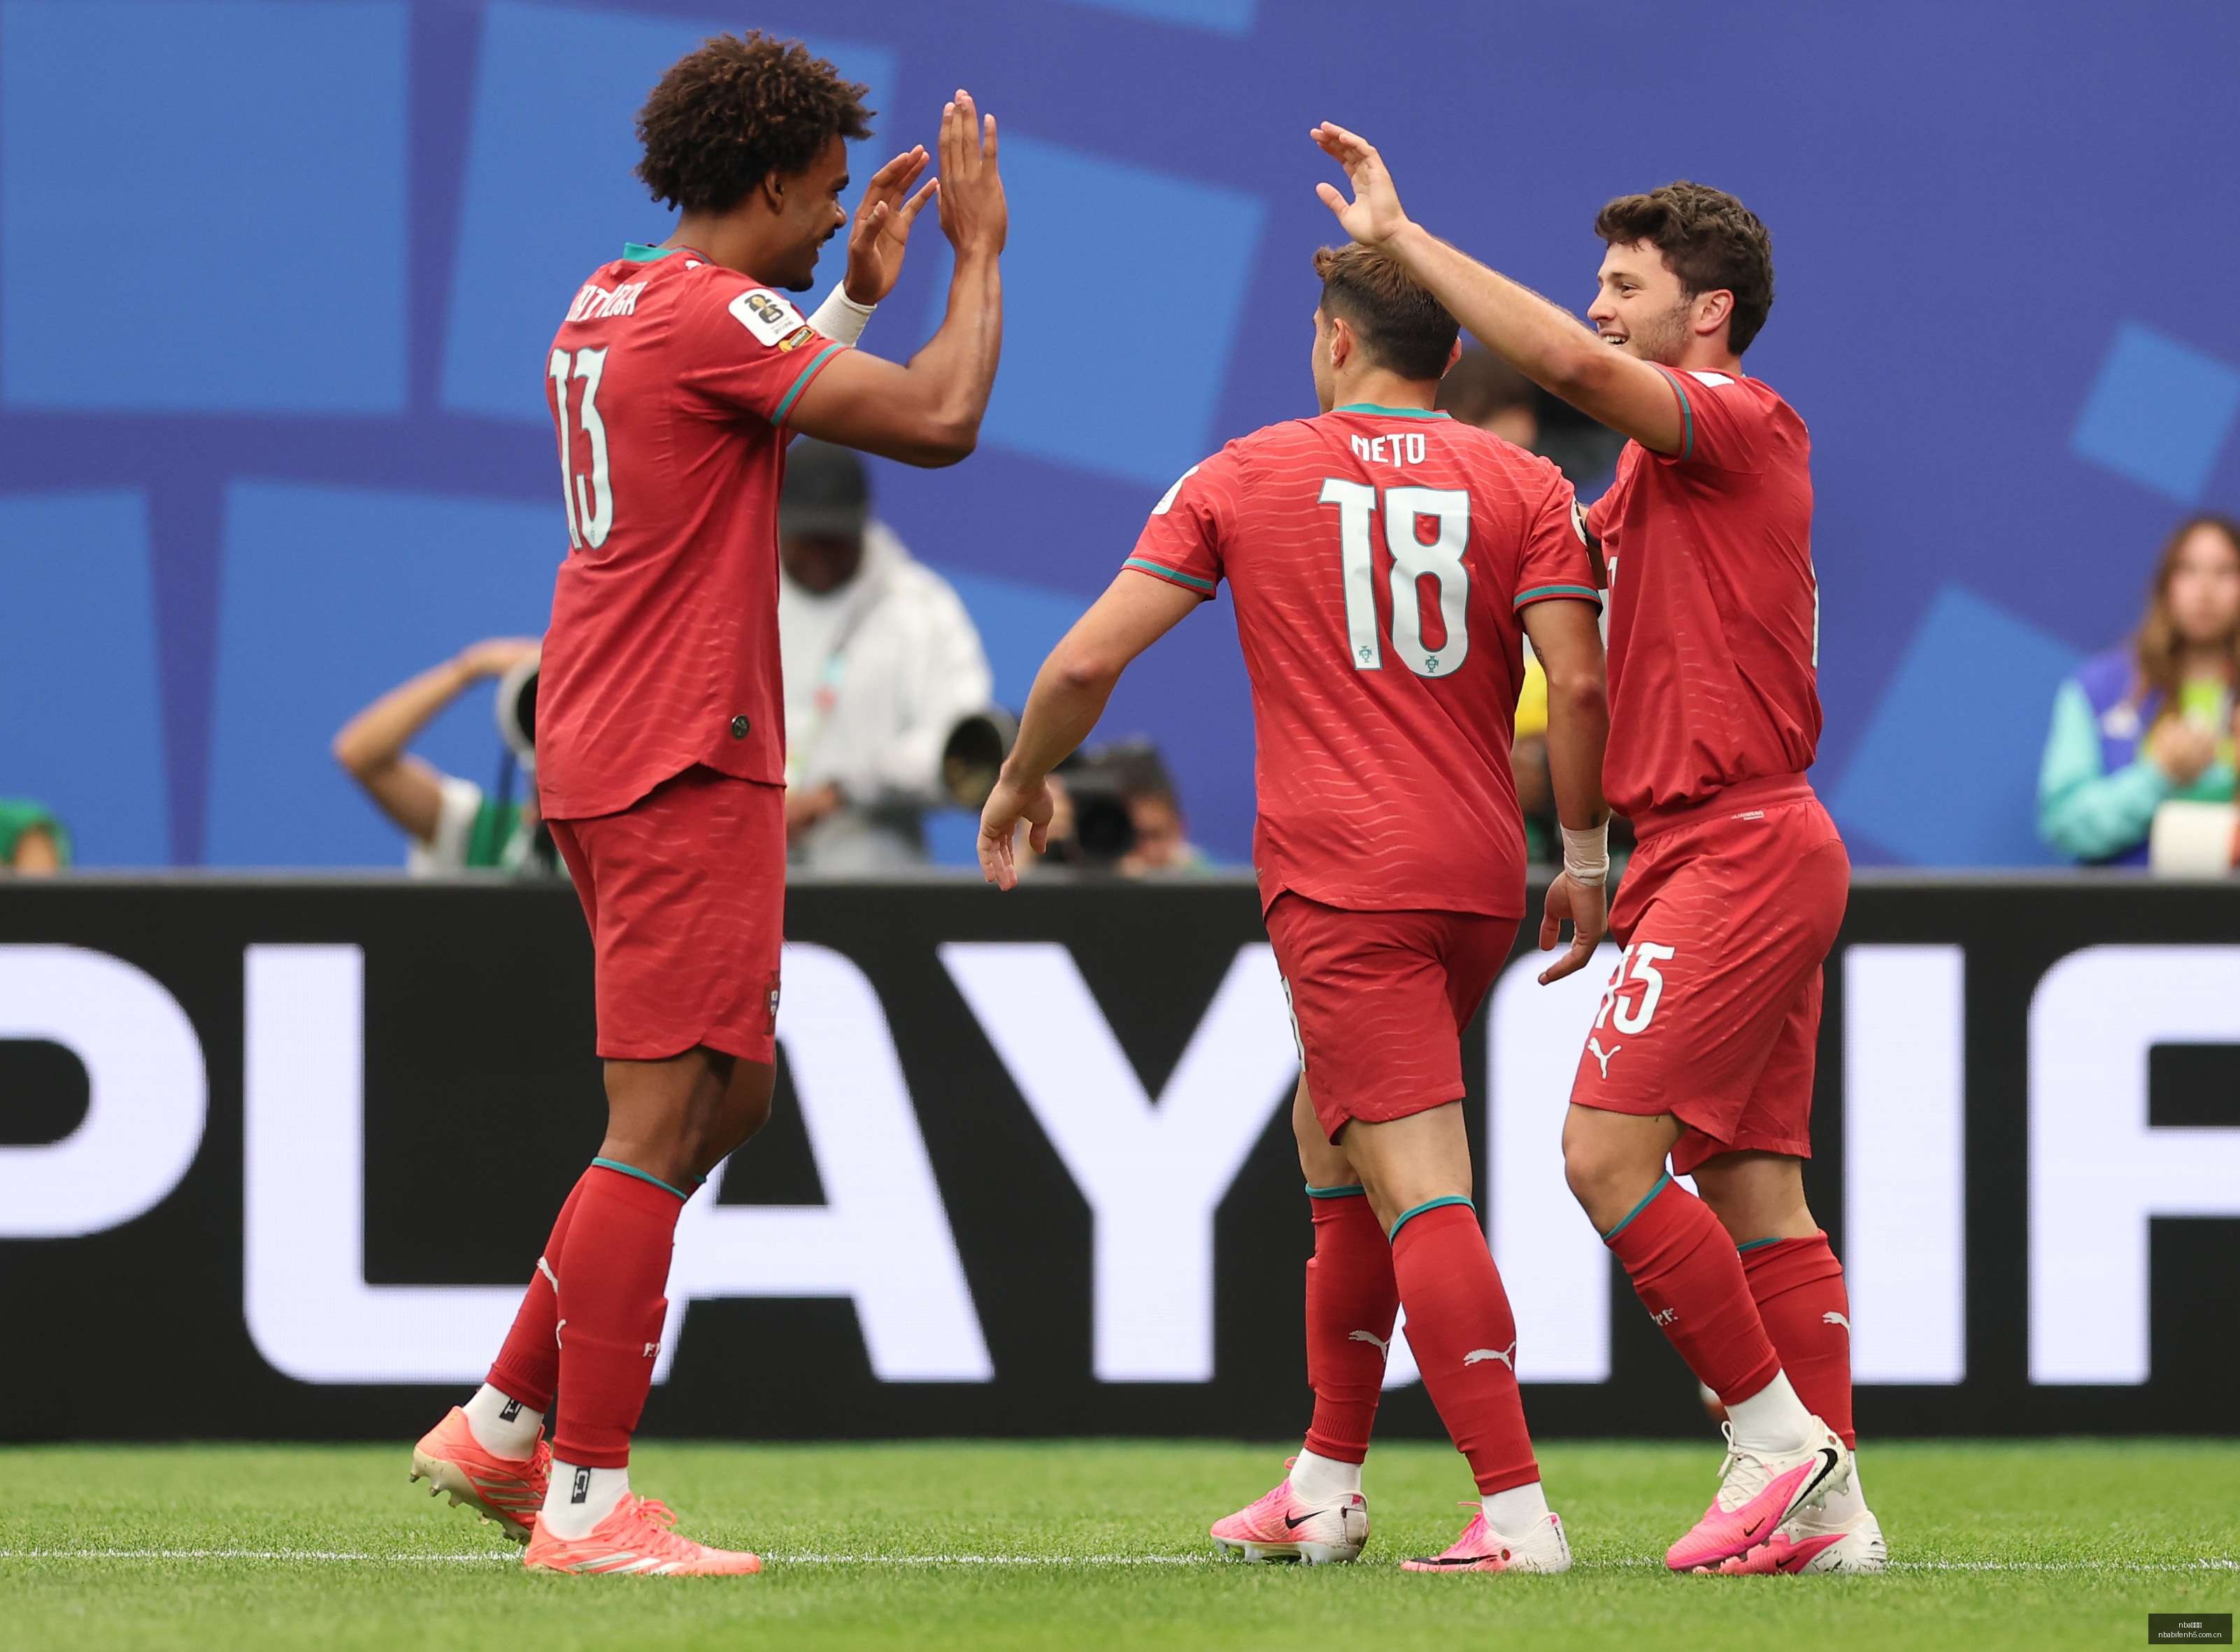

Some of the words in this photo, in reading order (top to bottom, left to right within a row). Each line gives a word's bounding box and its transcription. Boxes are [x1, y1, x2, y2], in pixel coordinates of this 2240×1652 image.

[549, 347, 613, 550] 13
[1350, 433, 1426, 467] NETO
[1317, 477, 1470, 678] 18
